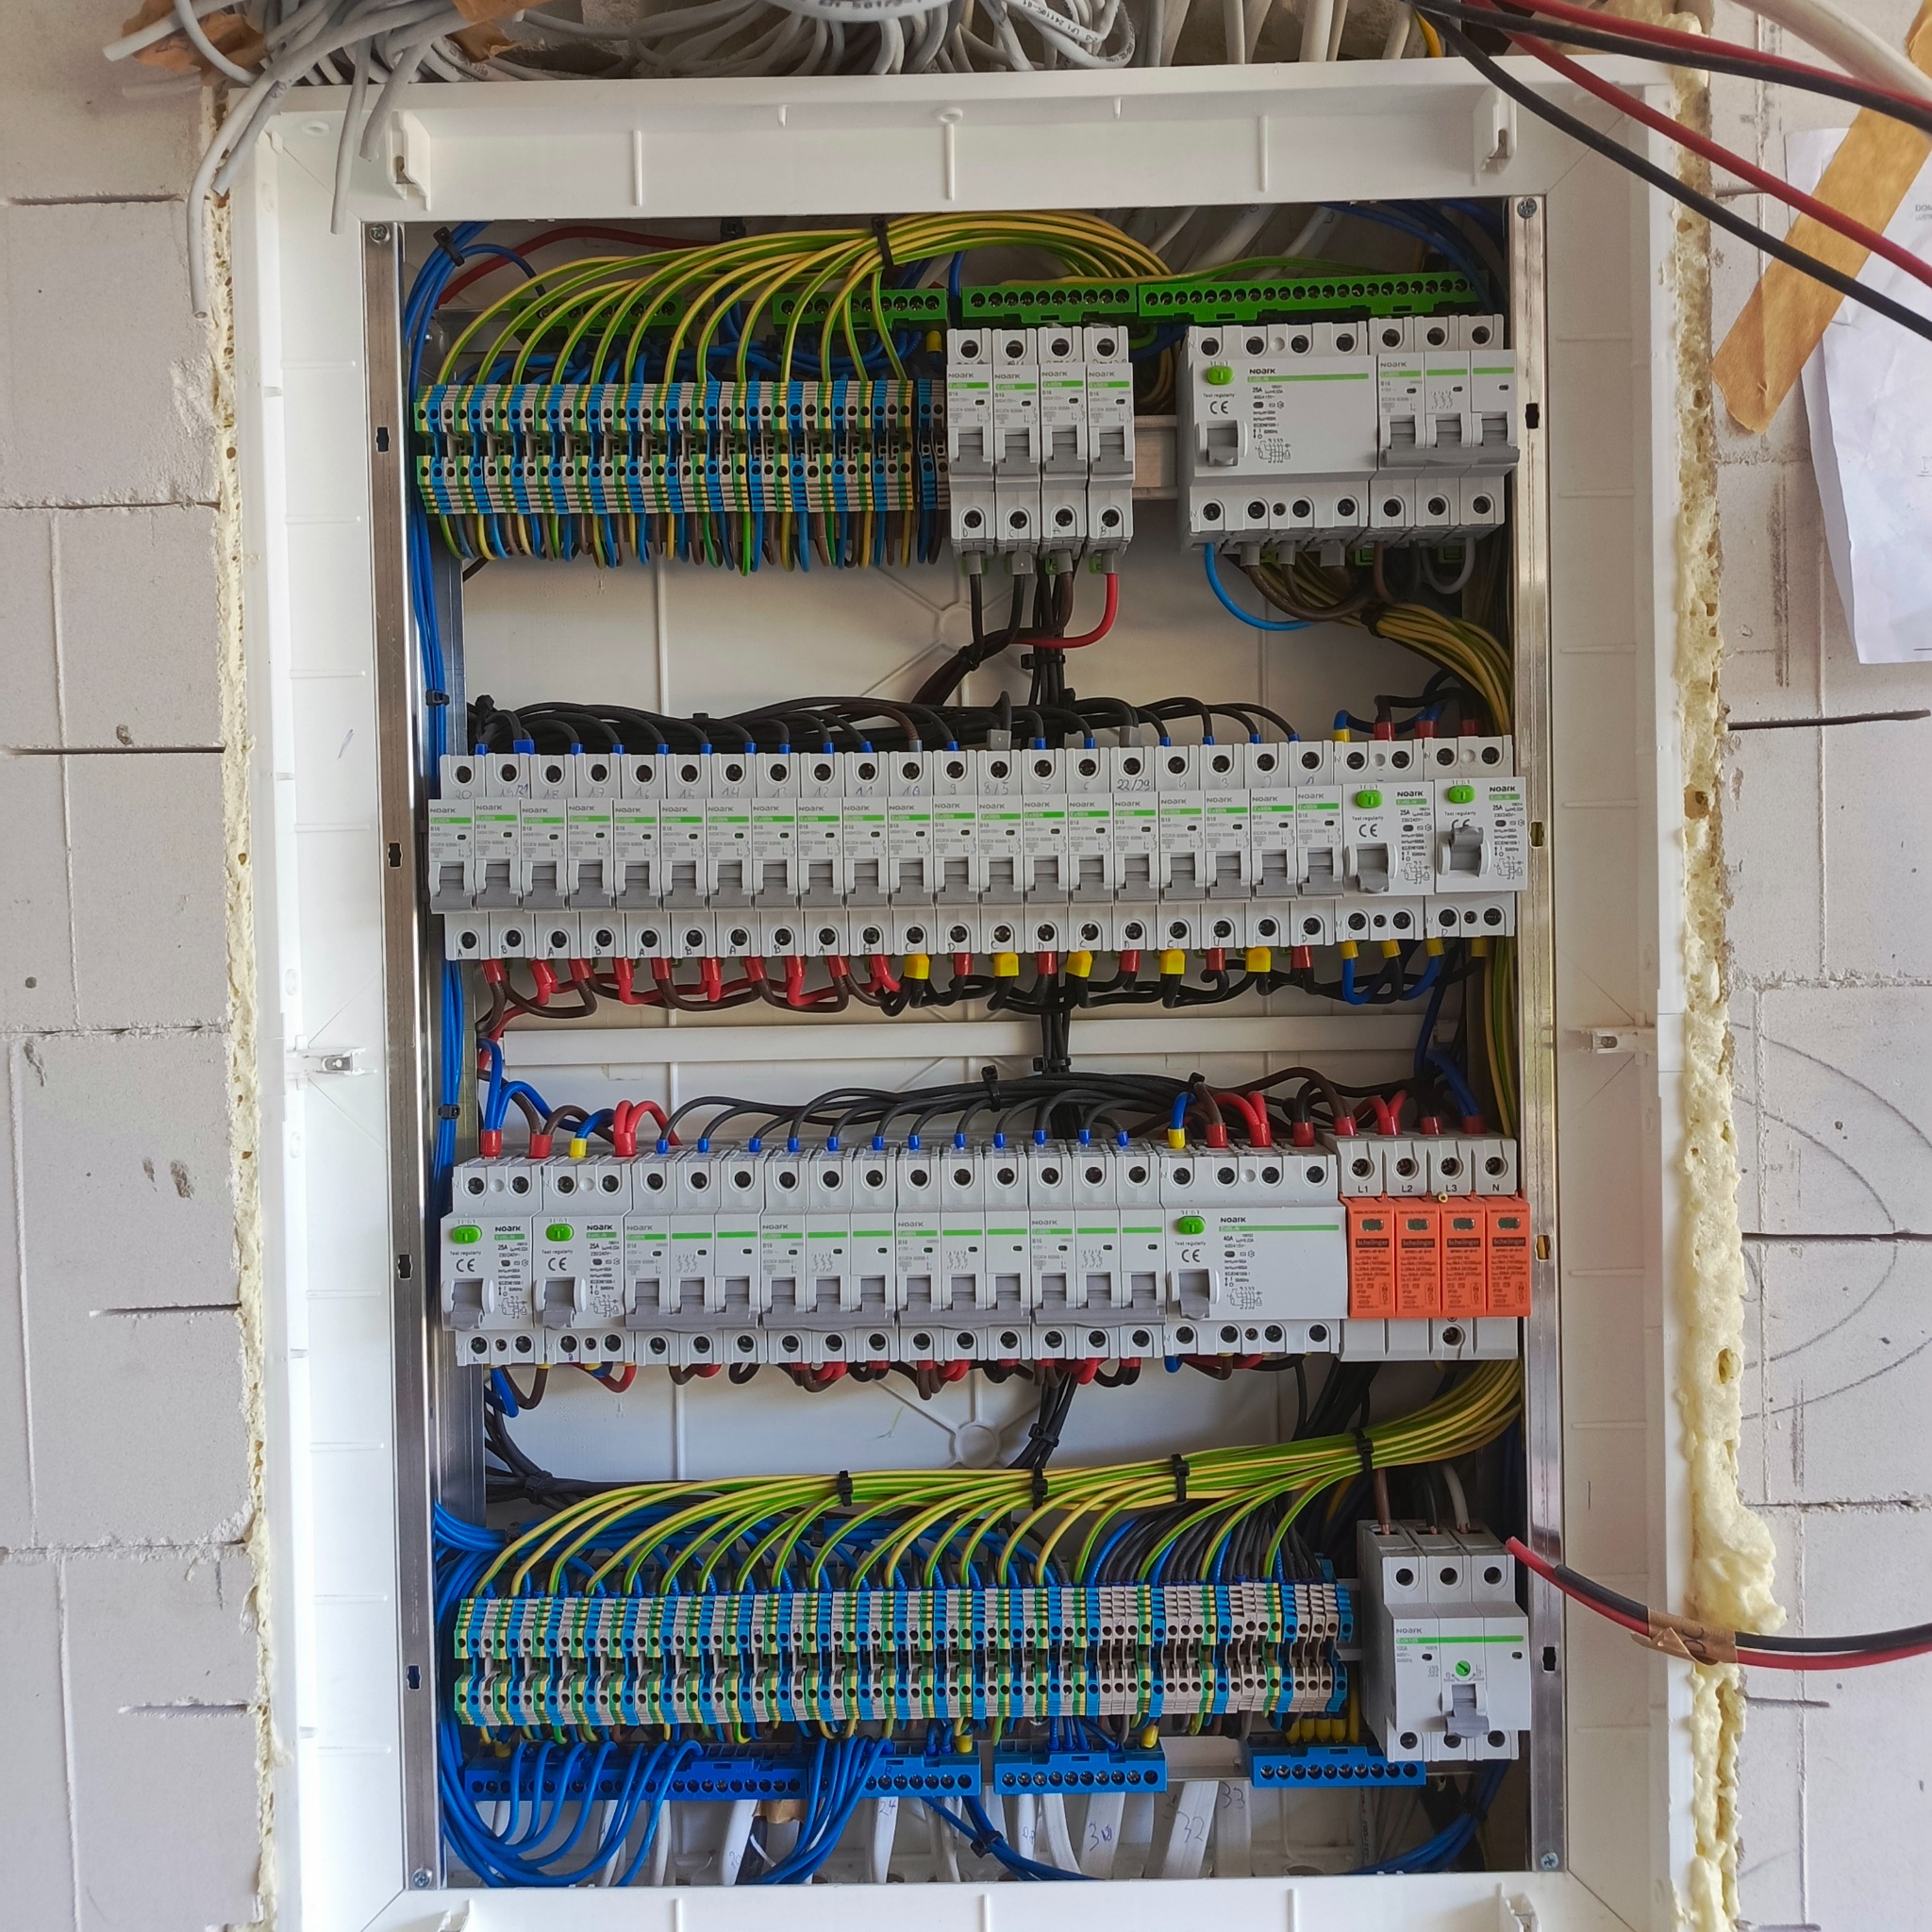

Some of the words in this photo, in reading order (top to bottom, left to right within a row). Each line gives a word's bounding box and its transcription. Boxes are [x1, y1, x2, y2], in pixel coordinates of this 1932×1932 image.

[1209, 400, 1228, 415] CE
[856, 785, 873, 796] 11
[1117, 778, 1150, 791] 22/29
[456, 790, 473, 800] 20
[722, 787, 740, 798] 14
[1358, 824, 1377, 838] CE
[1357, 1185, 1368, 1193] L1
[1401, 1185, 1413, 1193] L2
[1445, 1184, 1457, 1192] L3
[1181, 1249, 1200, 1263] CE
[456, 1257, 475, 1273] CE
[547, 1257, 567, 1271] CE
[1222, 1781, 1245, 1808] 33
[879, 1799, 896, 1816] 24
[1176, 1810, 1204, 1843] 32
